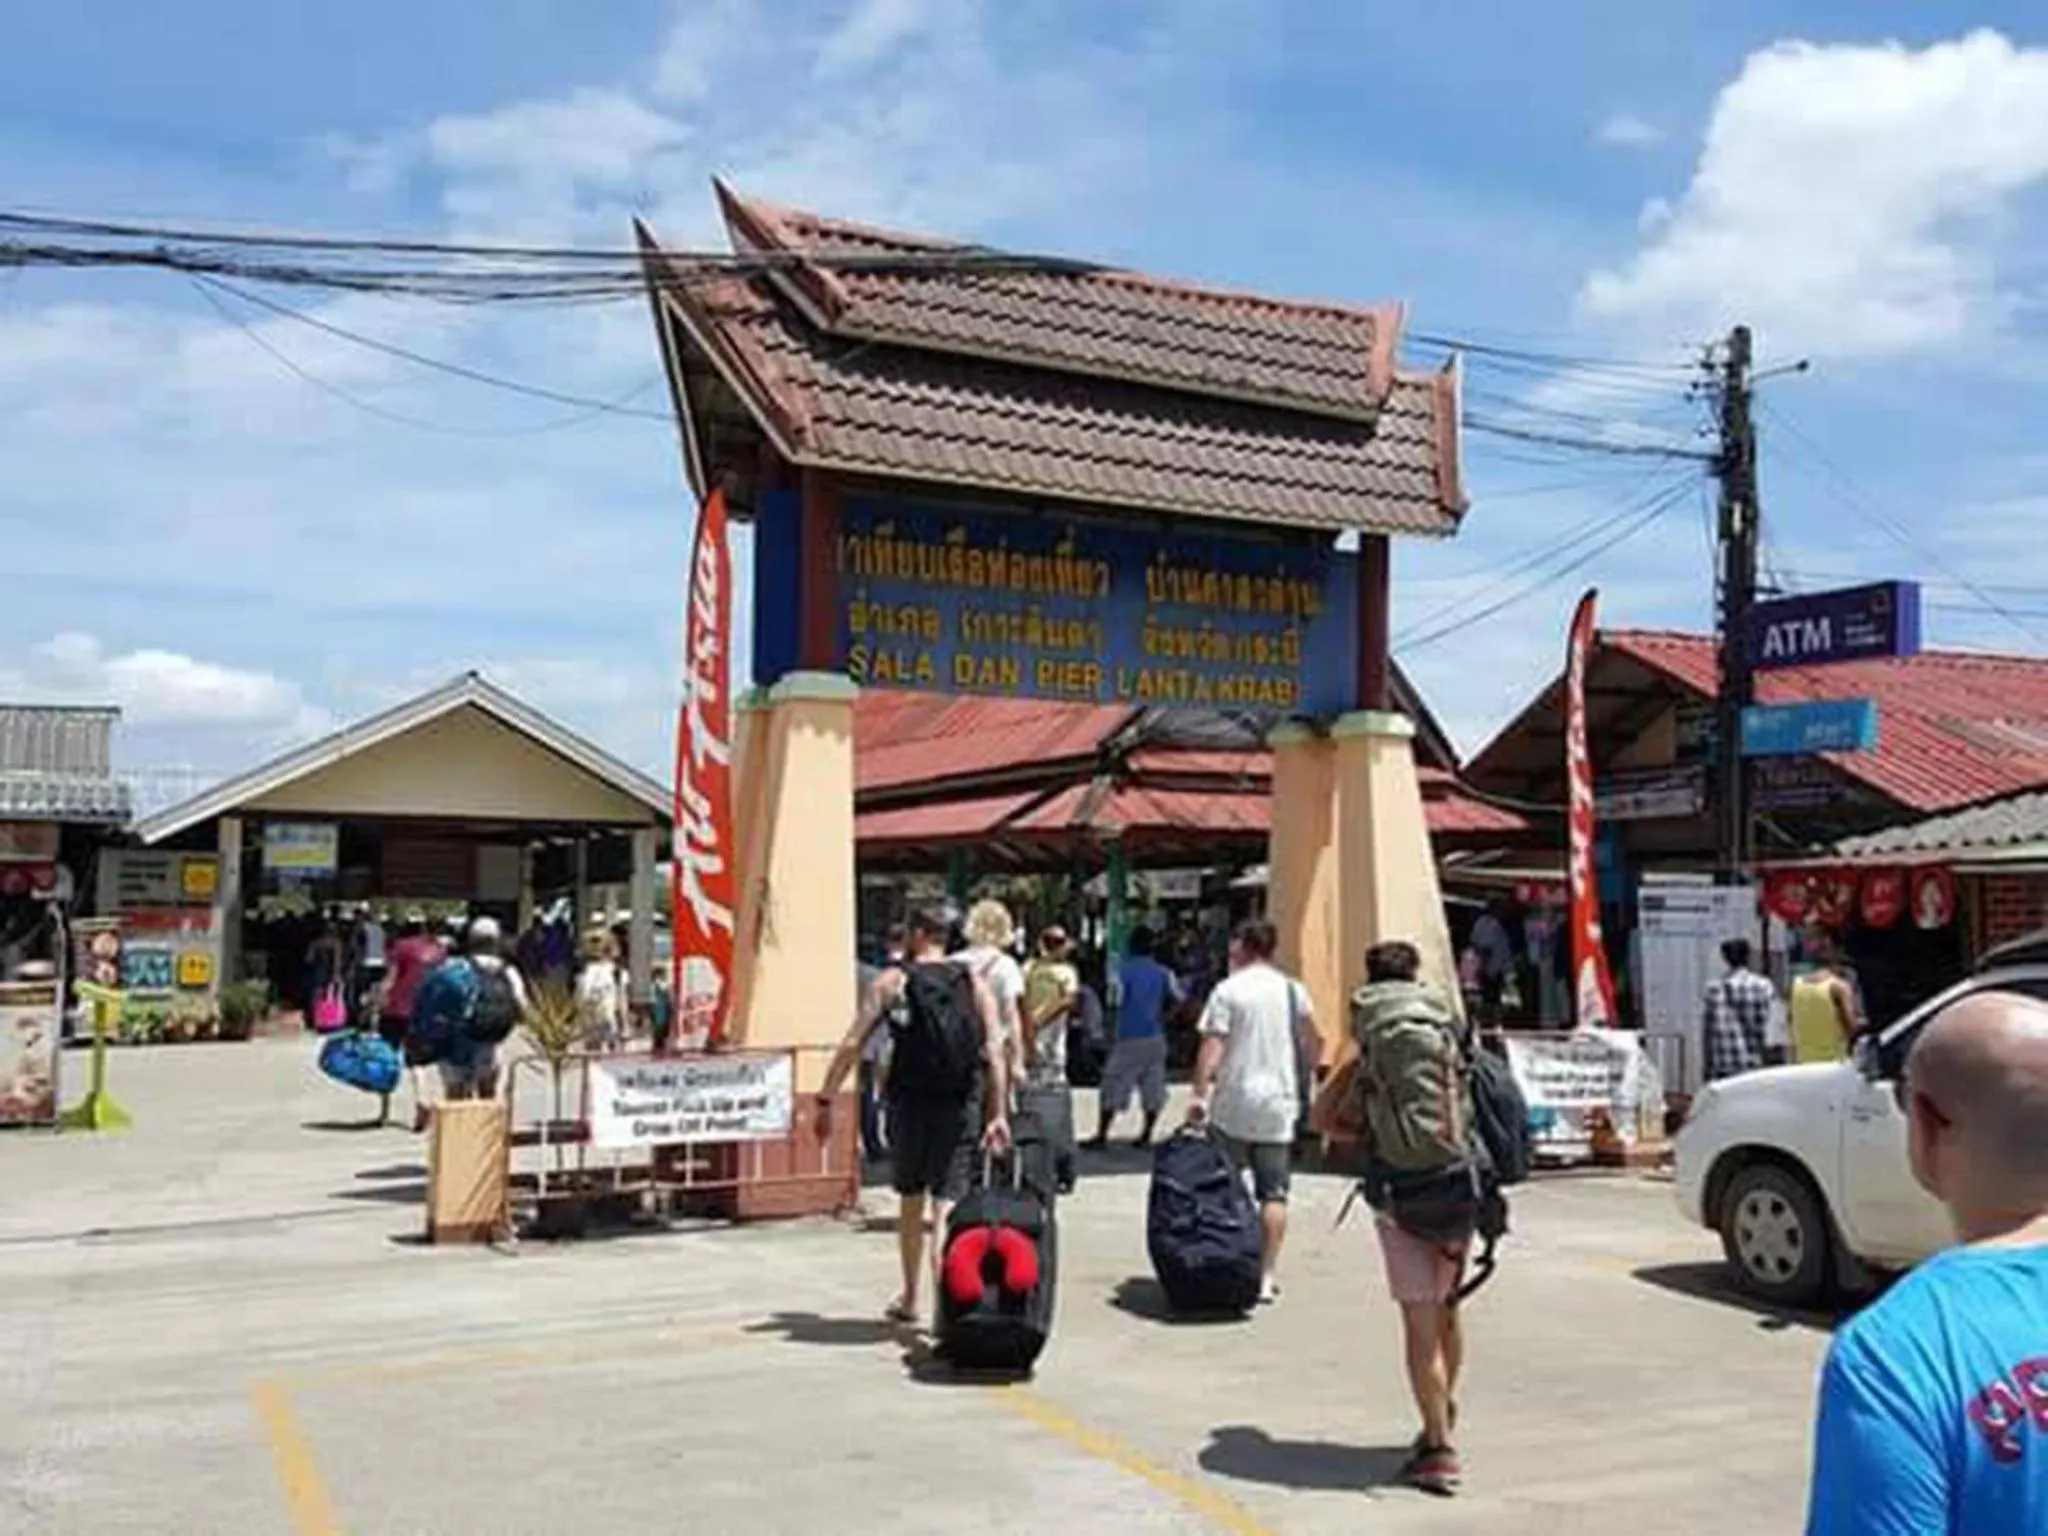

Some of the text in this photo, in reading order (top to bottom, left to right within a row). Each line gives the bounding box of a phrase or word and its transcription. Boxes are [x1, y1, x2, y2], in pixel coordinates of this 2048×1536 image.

[1763, 617, 1830, 658] ATM
[849, 645, 935, 683] SALA
[955, 654, 1021, 685] DAN
[1037, 660, 1101, 691] PIER
